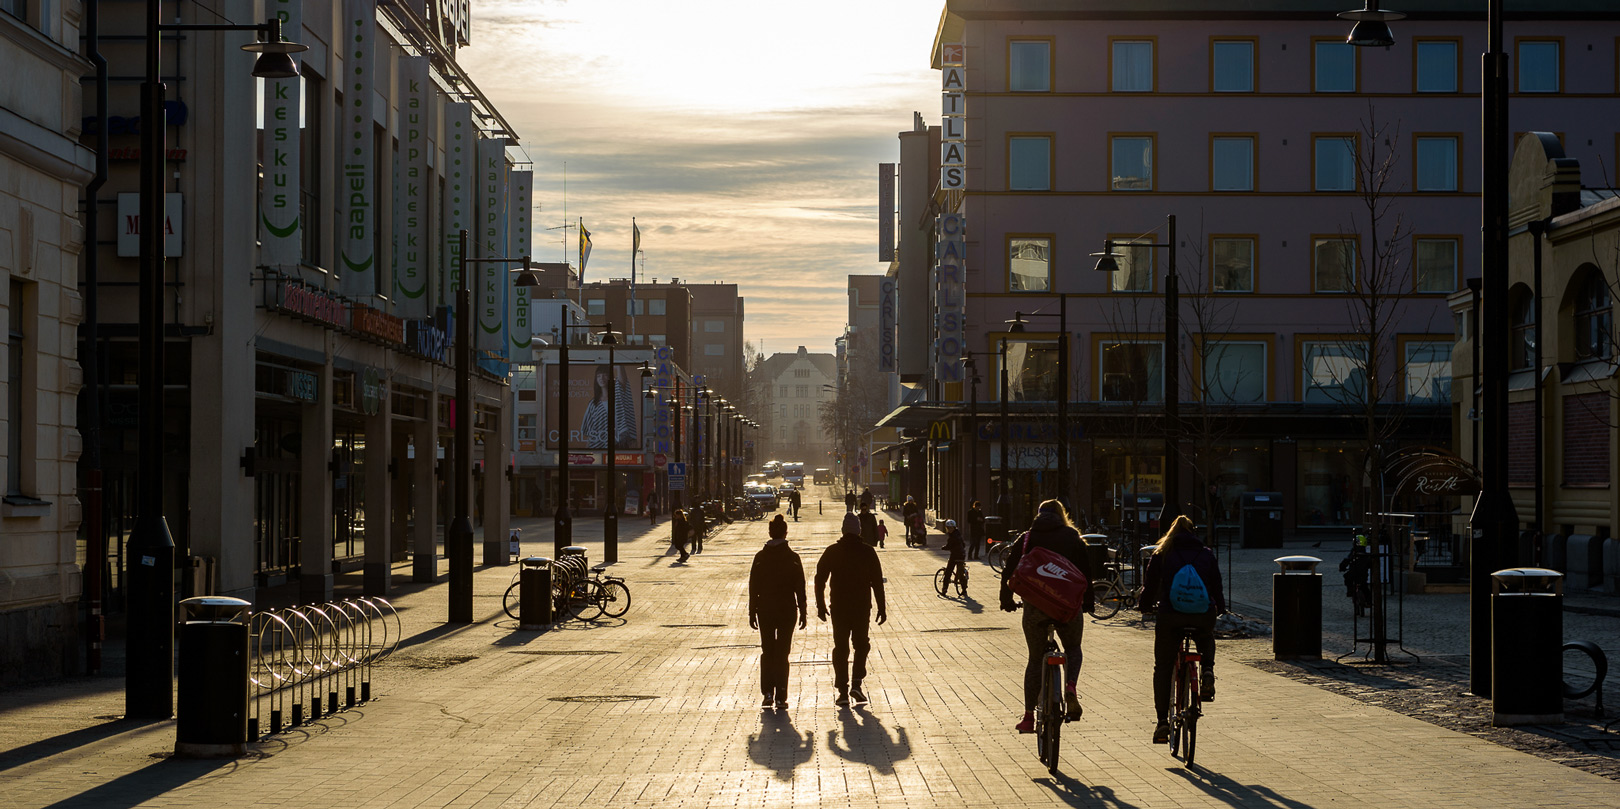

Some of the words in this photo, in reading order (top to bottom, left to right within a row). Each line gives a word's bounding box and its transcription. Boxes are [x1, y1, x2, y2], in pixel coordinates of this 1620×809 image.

[407, 79, 420, 278] kauppakeskus
[945, 69, 963, 187] ATLAS
[345, 164, 369, 240] aapeli
[882, 282, 893, 368] CARLSON
[942, 216, 959, 380] CARLSON
[657, 347, 669, 453] CARLSON
[1043, 562, 1068, 577] NIKE
